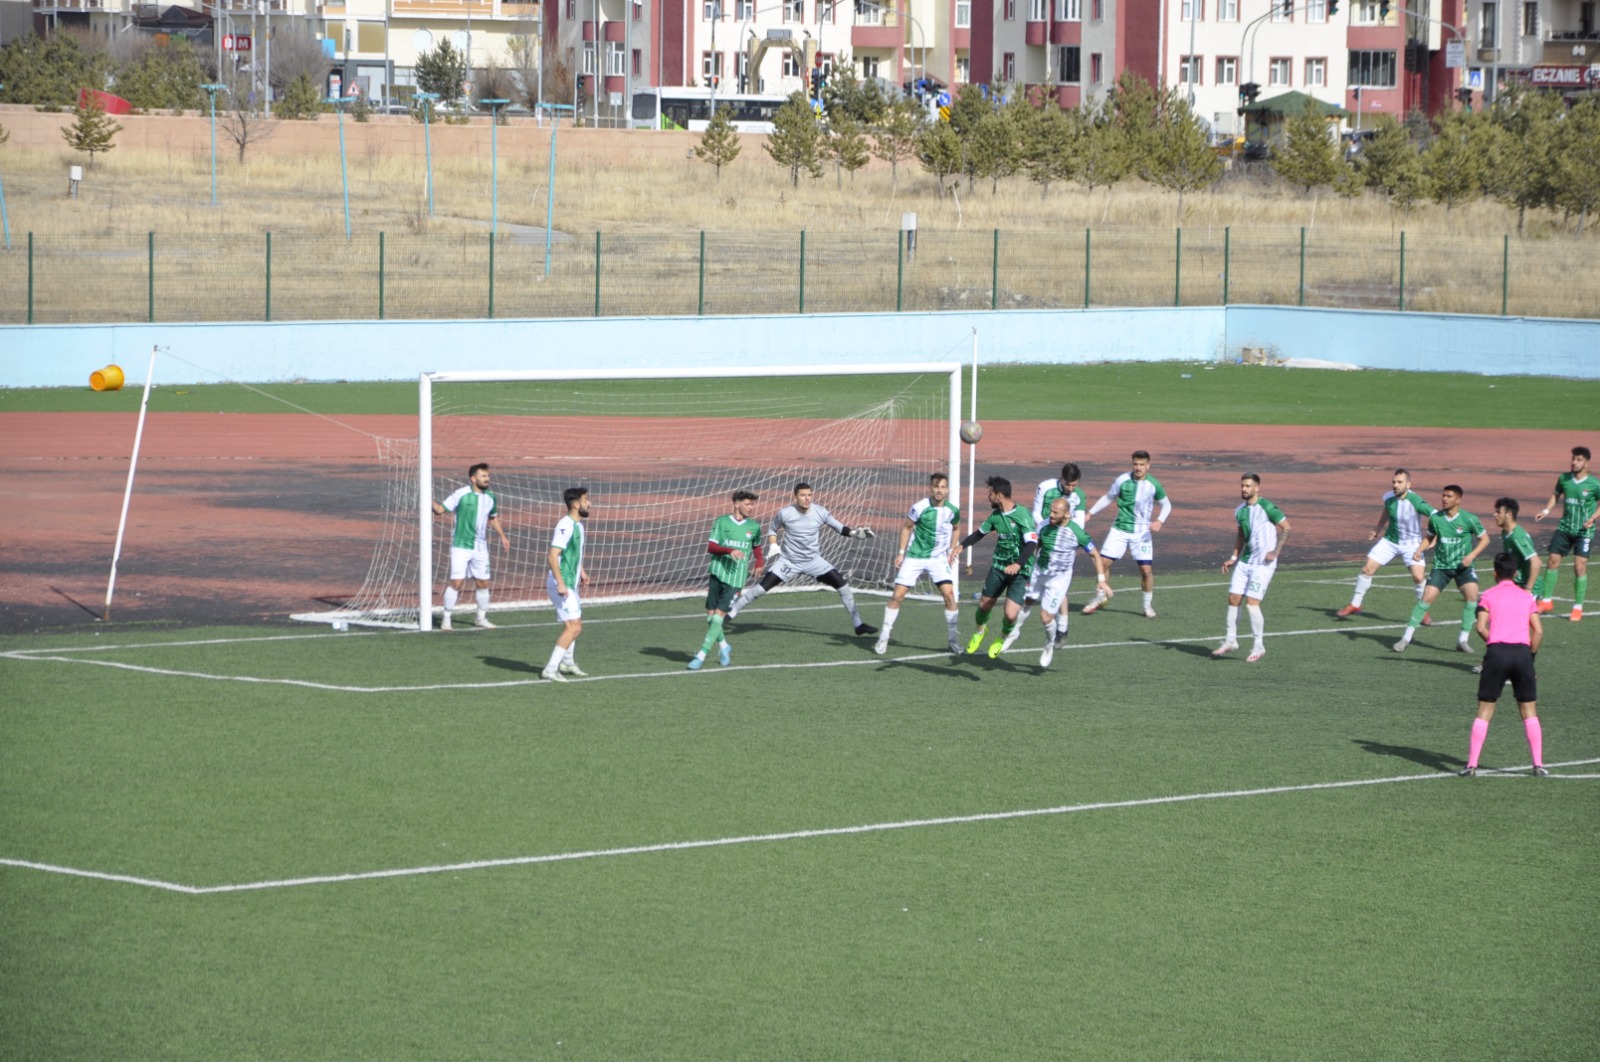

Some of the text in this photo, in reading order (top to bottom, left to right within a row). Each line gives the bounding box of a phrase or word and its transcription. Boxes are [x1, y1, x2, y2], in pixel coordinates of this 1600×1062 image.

[224, 37, 248, 49] BM
[1533, 68, 1580, 83] ECZANE
[1050, 598, 1058, 609] 5
